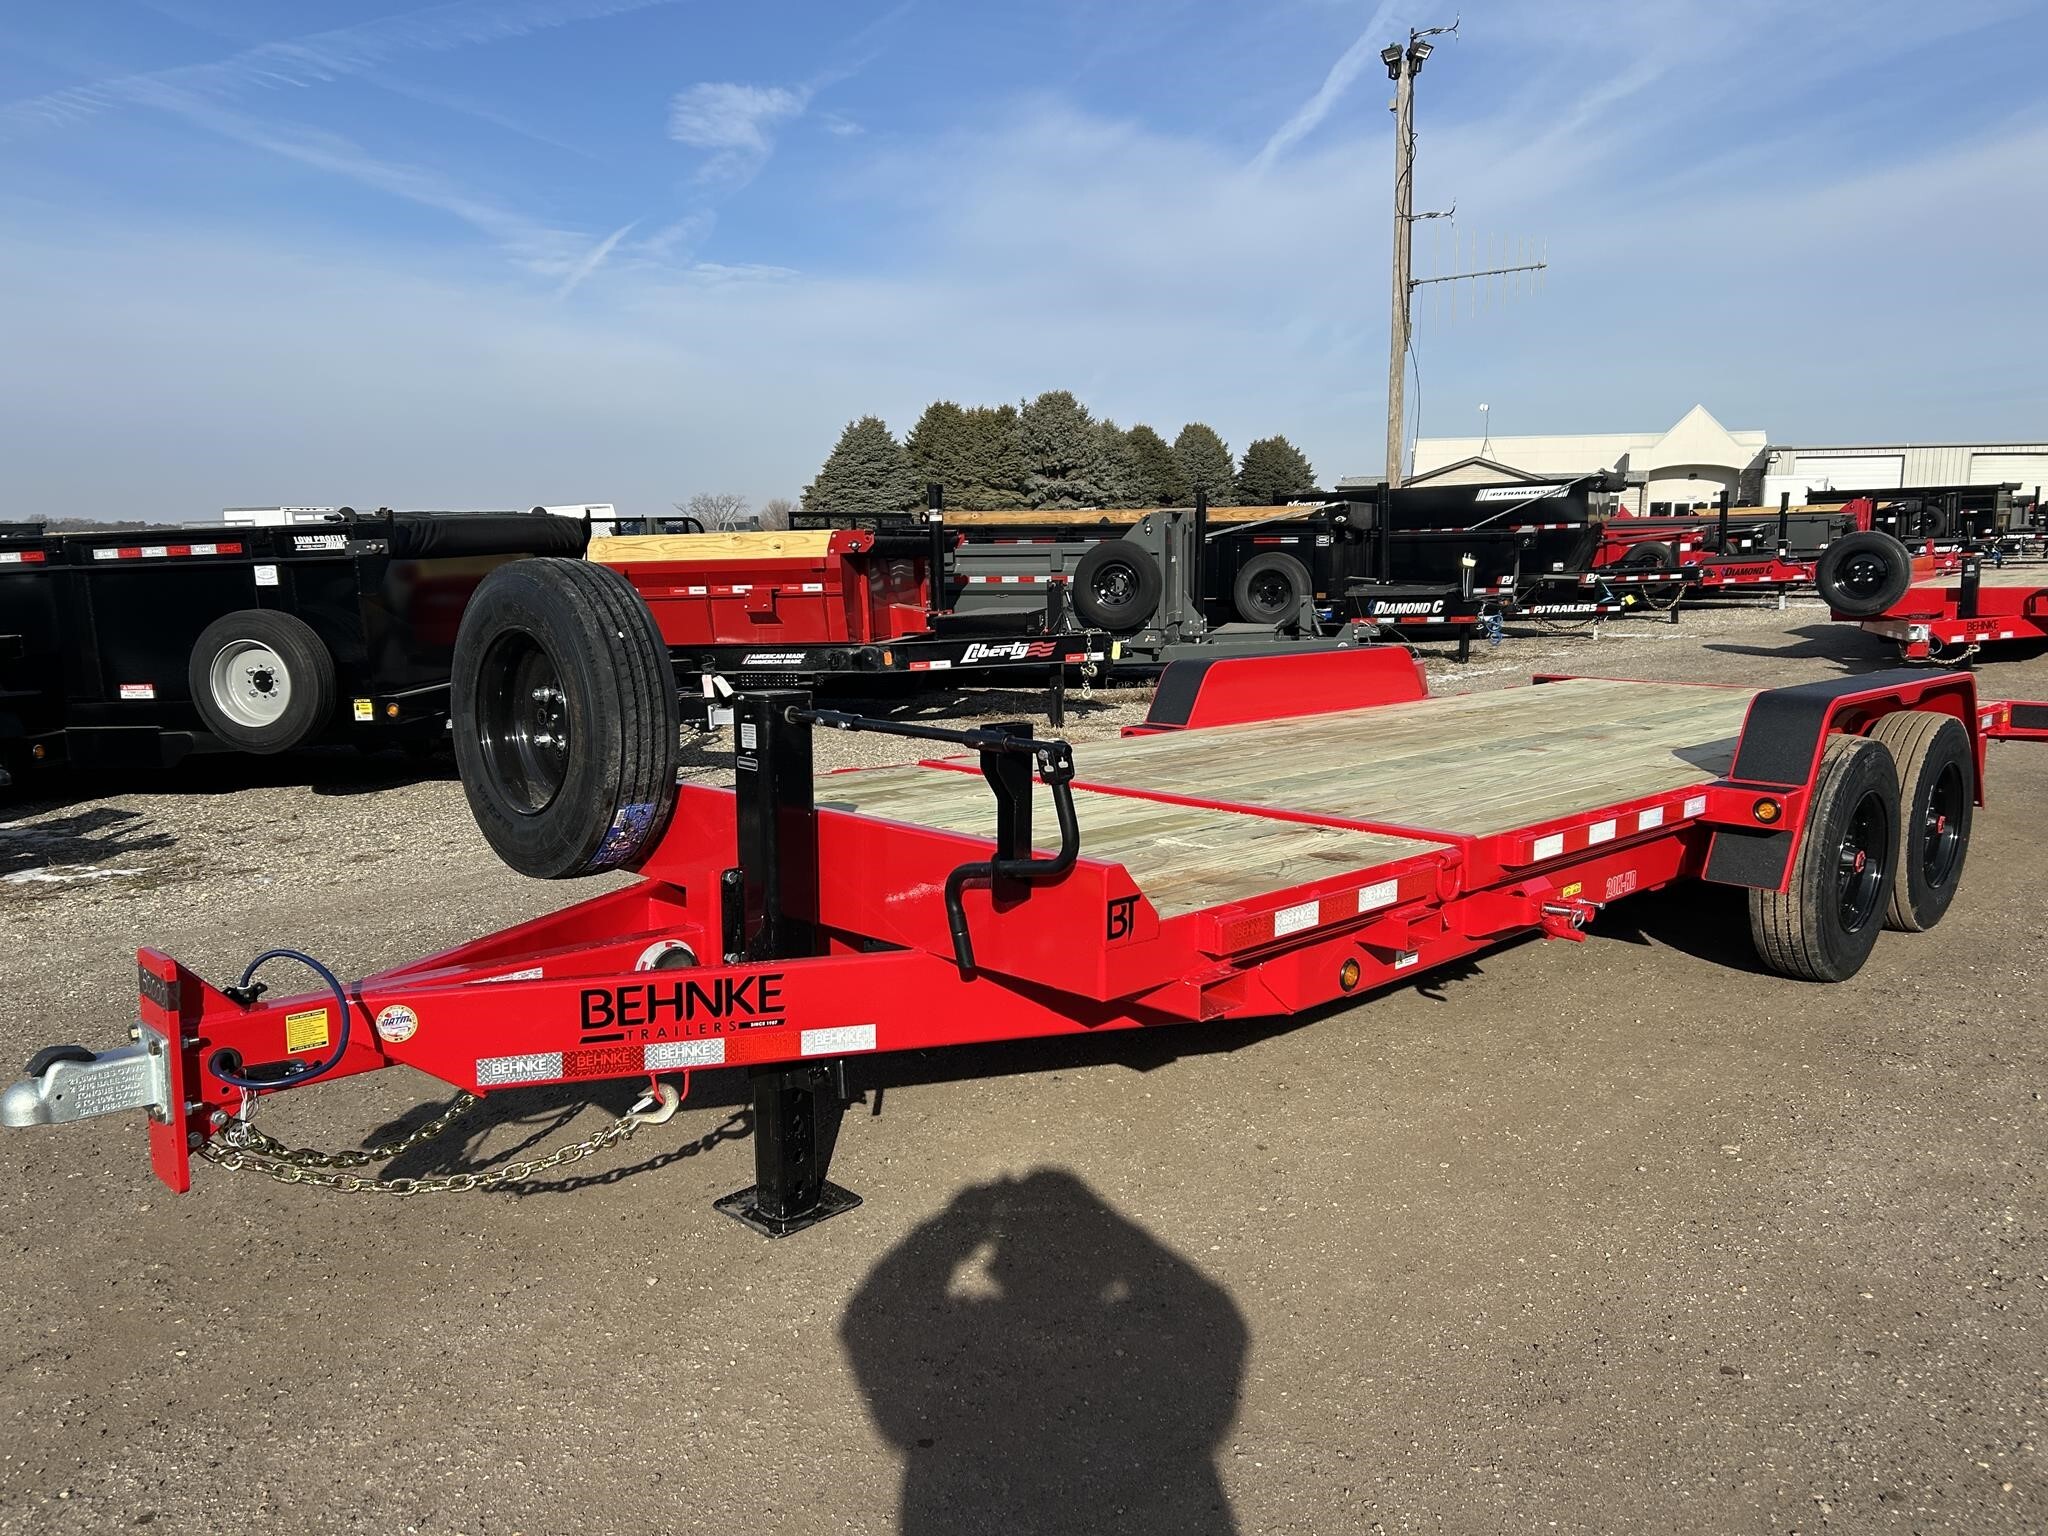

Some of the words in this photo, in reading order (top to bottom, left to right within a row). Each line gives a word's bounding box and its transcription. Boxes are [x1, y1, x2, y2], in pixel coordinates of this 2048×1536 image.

[293, 535, 312, 544] LOW
[313, 534, 348, 543] PROFILE
[1725, 566, 1764, 576] DIAMOND
[1765, 564, 1774, 575] C
[1500, 575, 1514, 585] PJ
[1373, 601, 1432, 615] DIAMOND
[1432, 600, 1444, 614] C
[1966, 620, 2000, 632] BEHNKE
[960, 641, 1030, 664] Liberty
[581, 973, 786, 1030] BEHNKE
[626, 1020, 737, 1042] TRAILERS
[576, 1052, 630, 1068] BEHNKE
[658, 1043, 712, 1061] BEHNKE
[491, 1059, 547, 1075] BEHNKE
[77, 1087, 114, 1100] TONGUE
[115, 1081, 141, 1093] LOAD
[83, 1099, 95, 1107] TO
